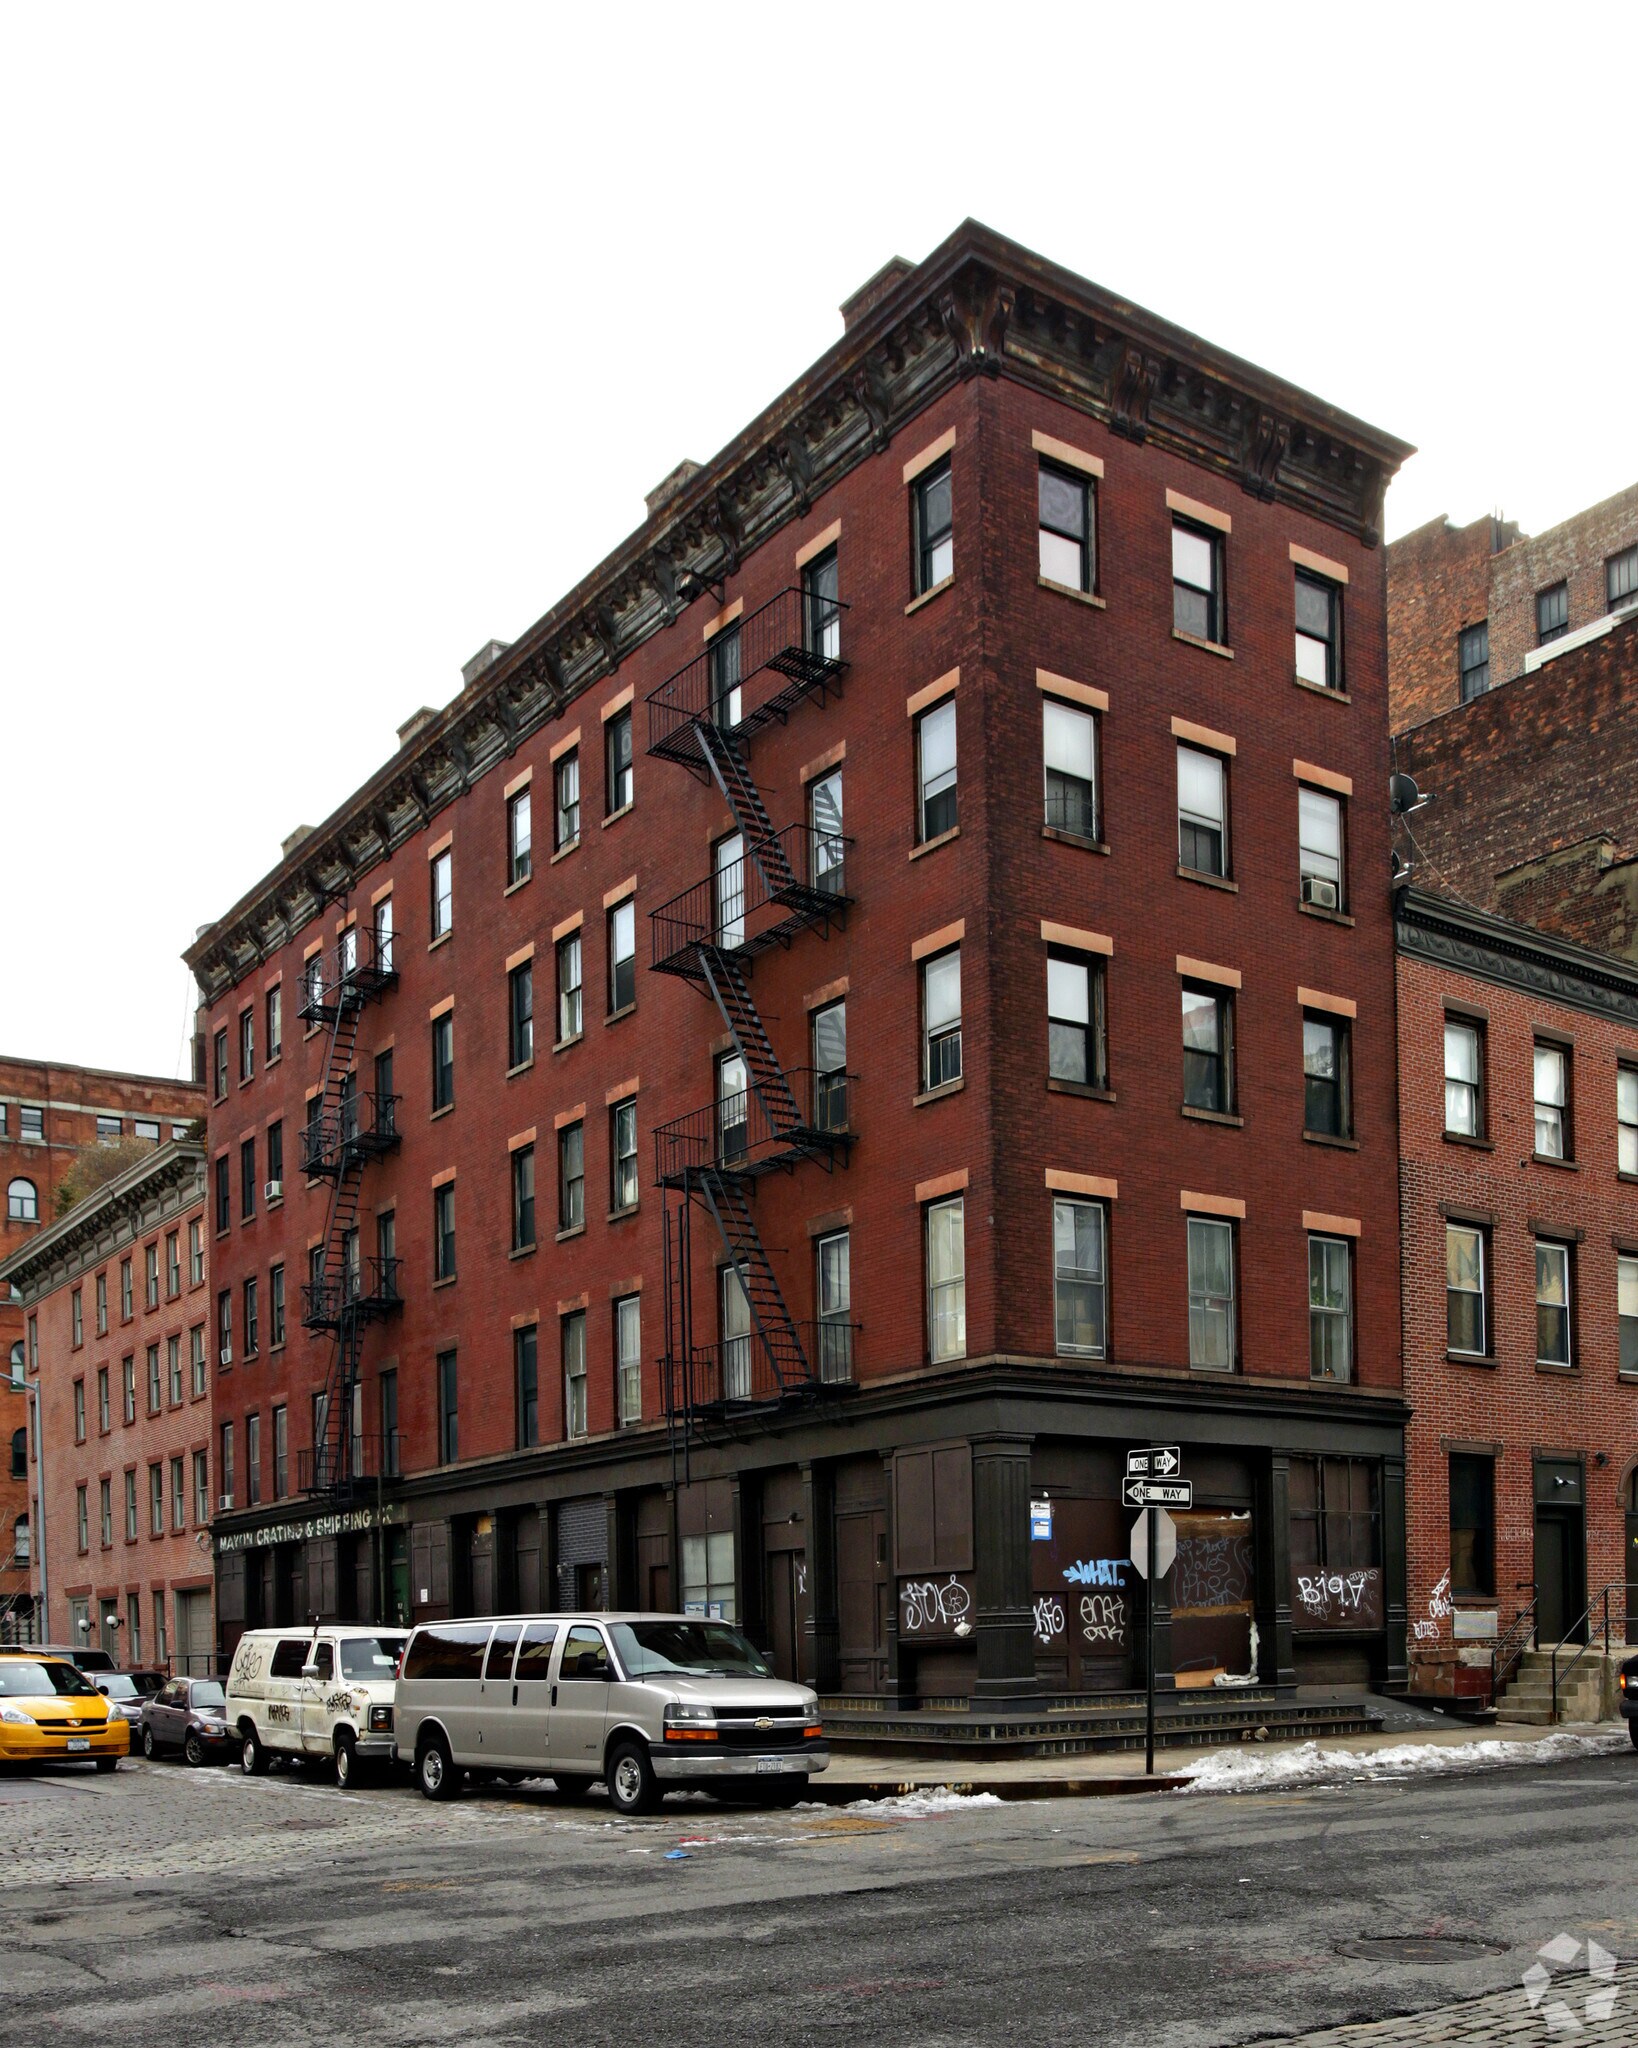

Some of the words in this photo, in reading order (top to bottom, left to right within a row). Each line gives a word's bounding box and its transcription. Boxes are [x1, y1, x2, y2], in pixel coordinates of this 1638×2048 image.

[1134, 1458, 1149, 1470] ONE
[1156, 1457, 1171, 1468] WAY
[1132, 1487, 1151, 1498] ONE
[1162, 1488, 1182, 1499] WAY
[256, 1522, 301, 1546] CRATING
[305, 1521, 314, 1538] &
[316, 1508, 373, 1536] SHIPPING
